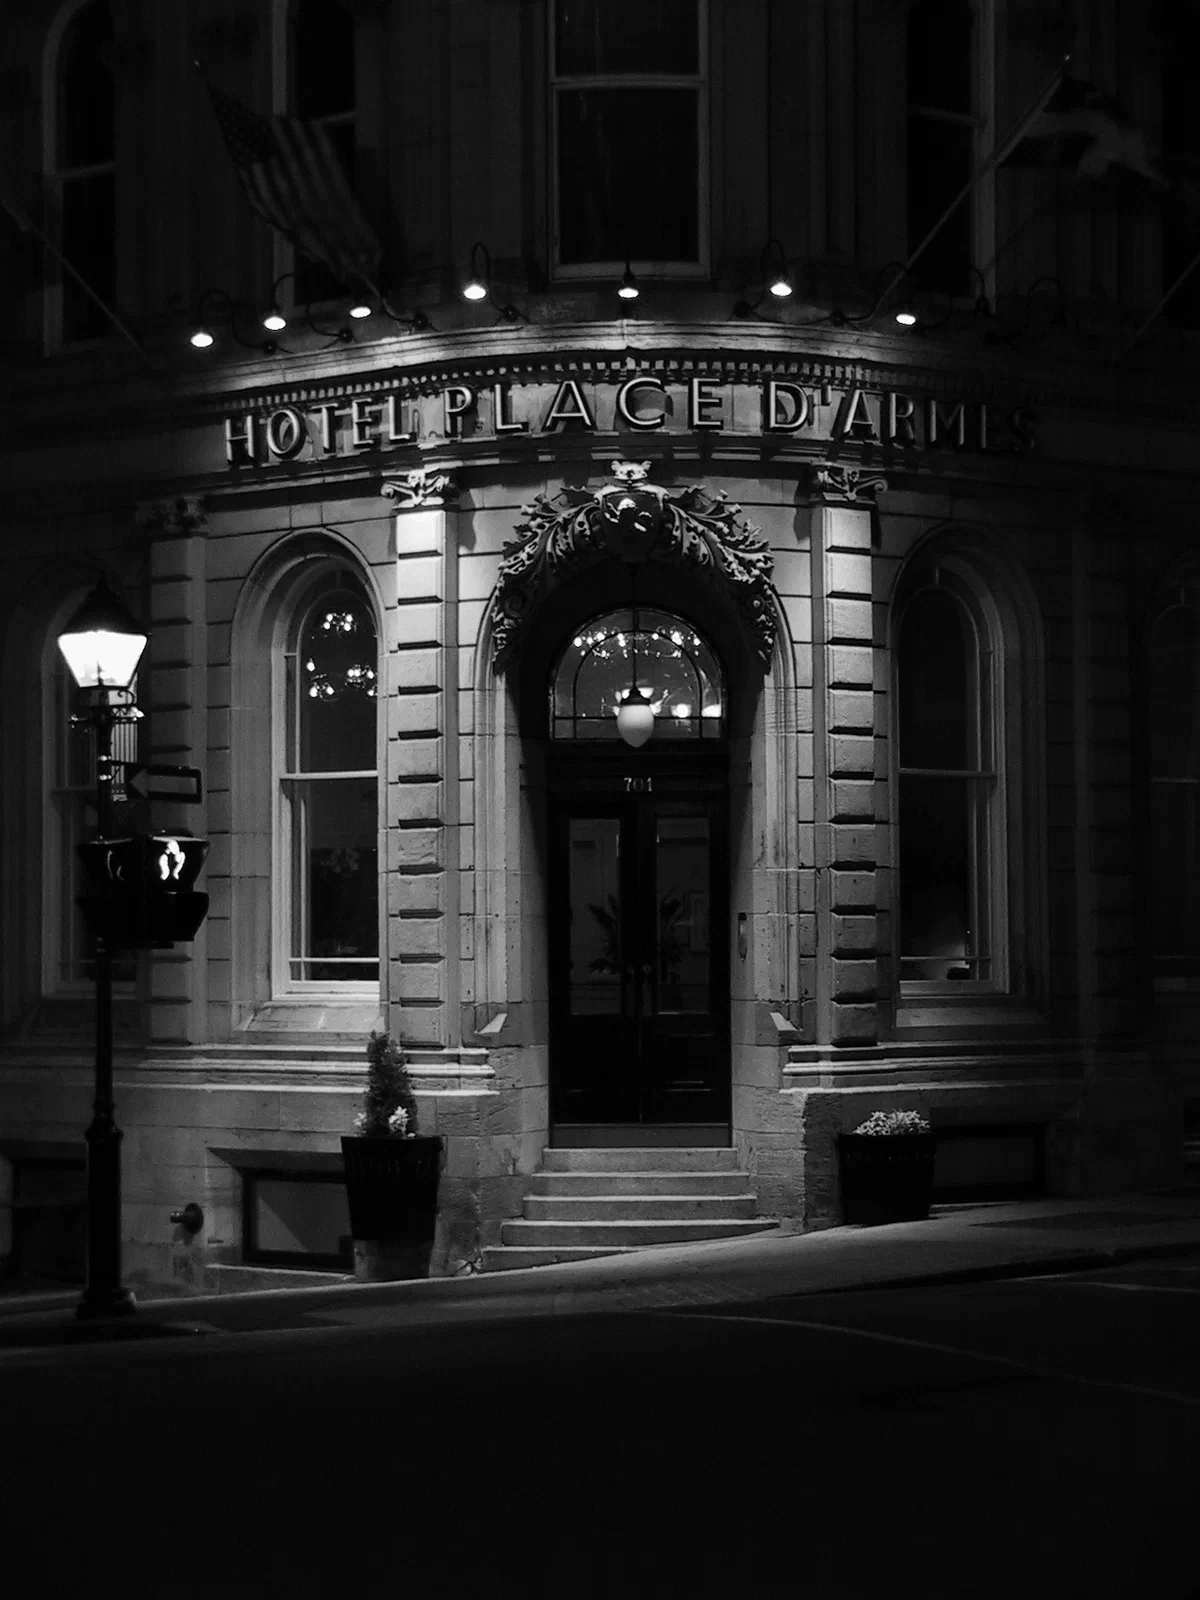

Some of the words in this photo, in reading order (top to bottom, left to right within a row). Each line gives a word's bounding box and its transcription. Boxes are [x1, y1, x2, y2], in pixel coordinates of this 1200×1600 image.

[224, 396, 411, 461] HOTEL
[444, 377, 725, 438] PLACE
[623, 777, 653, 792] 701
